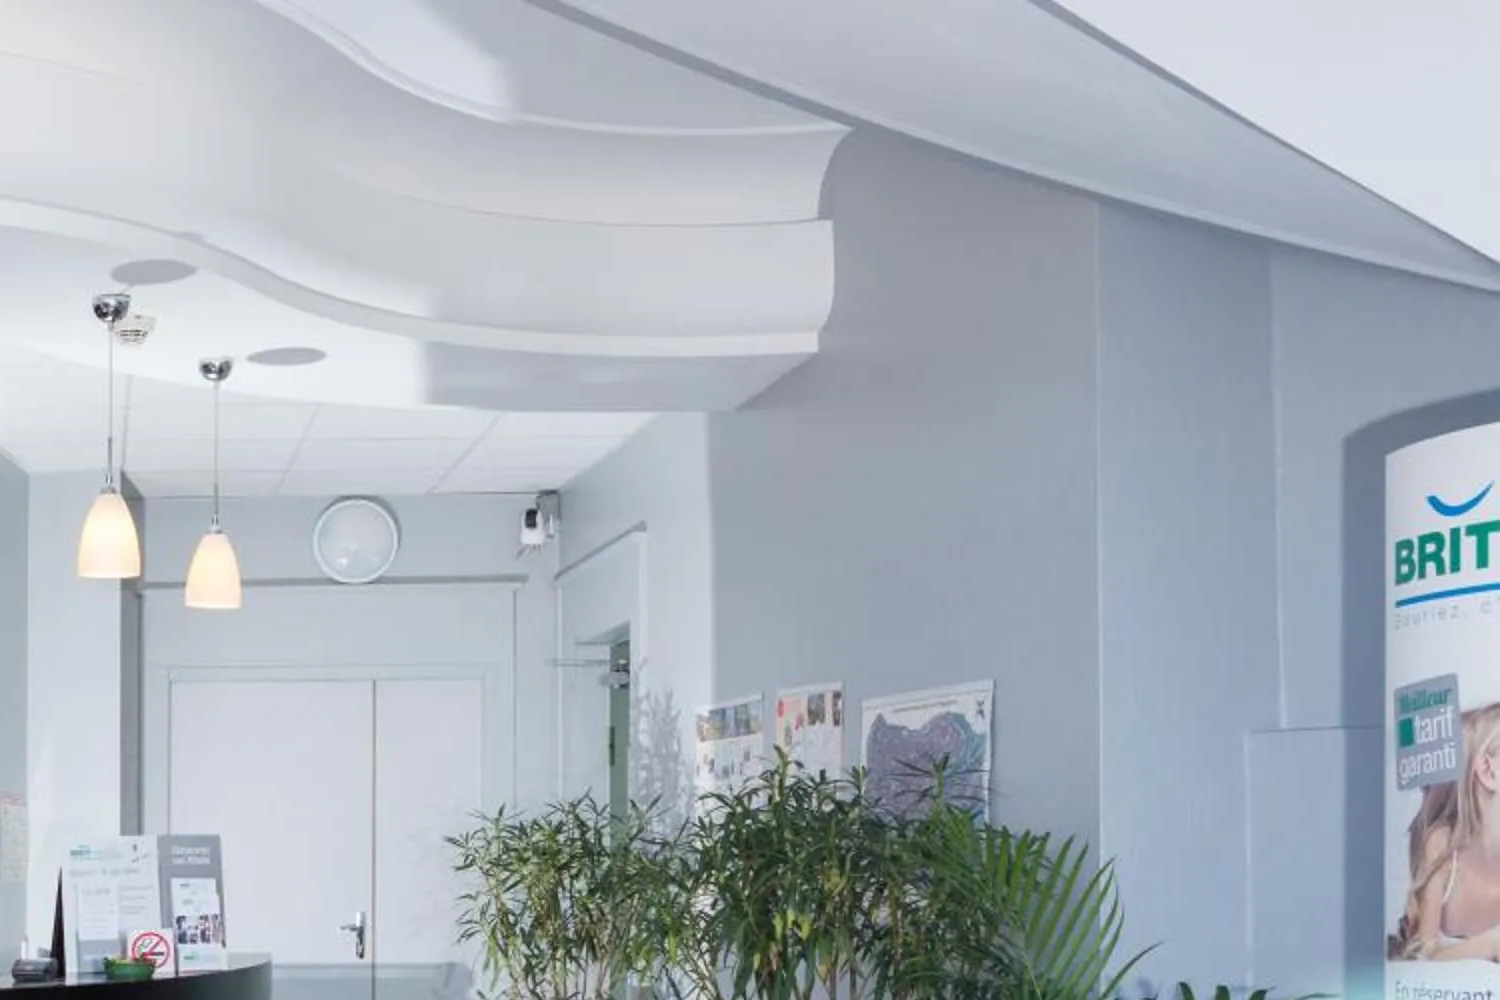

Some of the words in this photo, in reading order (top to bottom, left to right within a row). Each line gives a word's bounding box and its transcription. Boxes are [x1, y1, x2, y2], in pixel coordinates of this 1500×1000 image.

[1395, 520, 1500, 586] BRIT
[1415, 705, 1454, 744] tarif
[1400, 741, 1456, 785] garanti
[1396, 980, 1409, 1000] En
